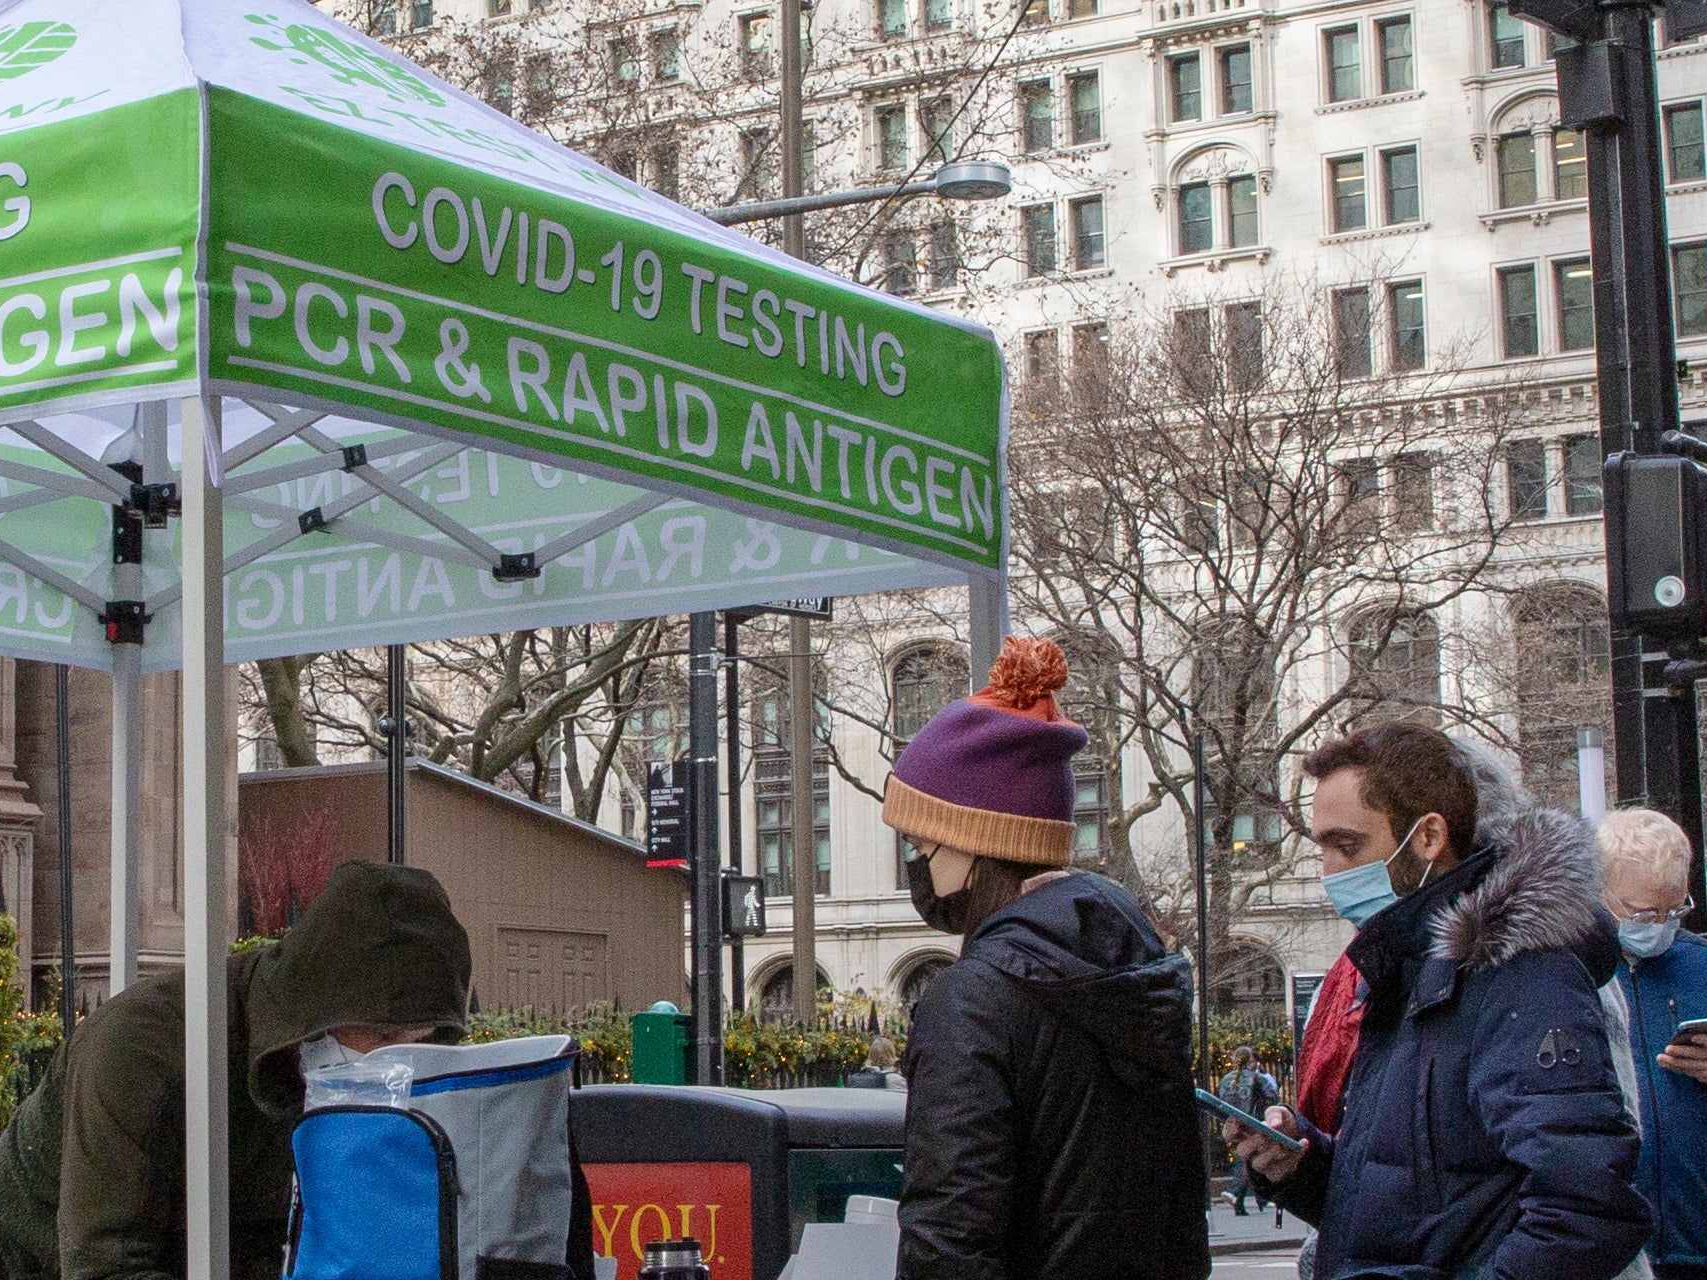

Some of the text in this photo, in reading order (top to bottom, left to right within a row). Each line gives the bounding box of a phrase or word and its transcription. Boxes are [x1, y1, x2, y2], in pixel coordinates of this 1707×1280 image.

[231, 264, 994, 543] PCR & RAPID ANTIGEN
[371, 170, 908, 398] COVID-19 TESTING
